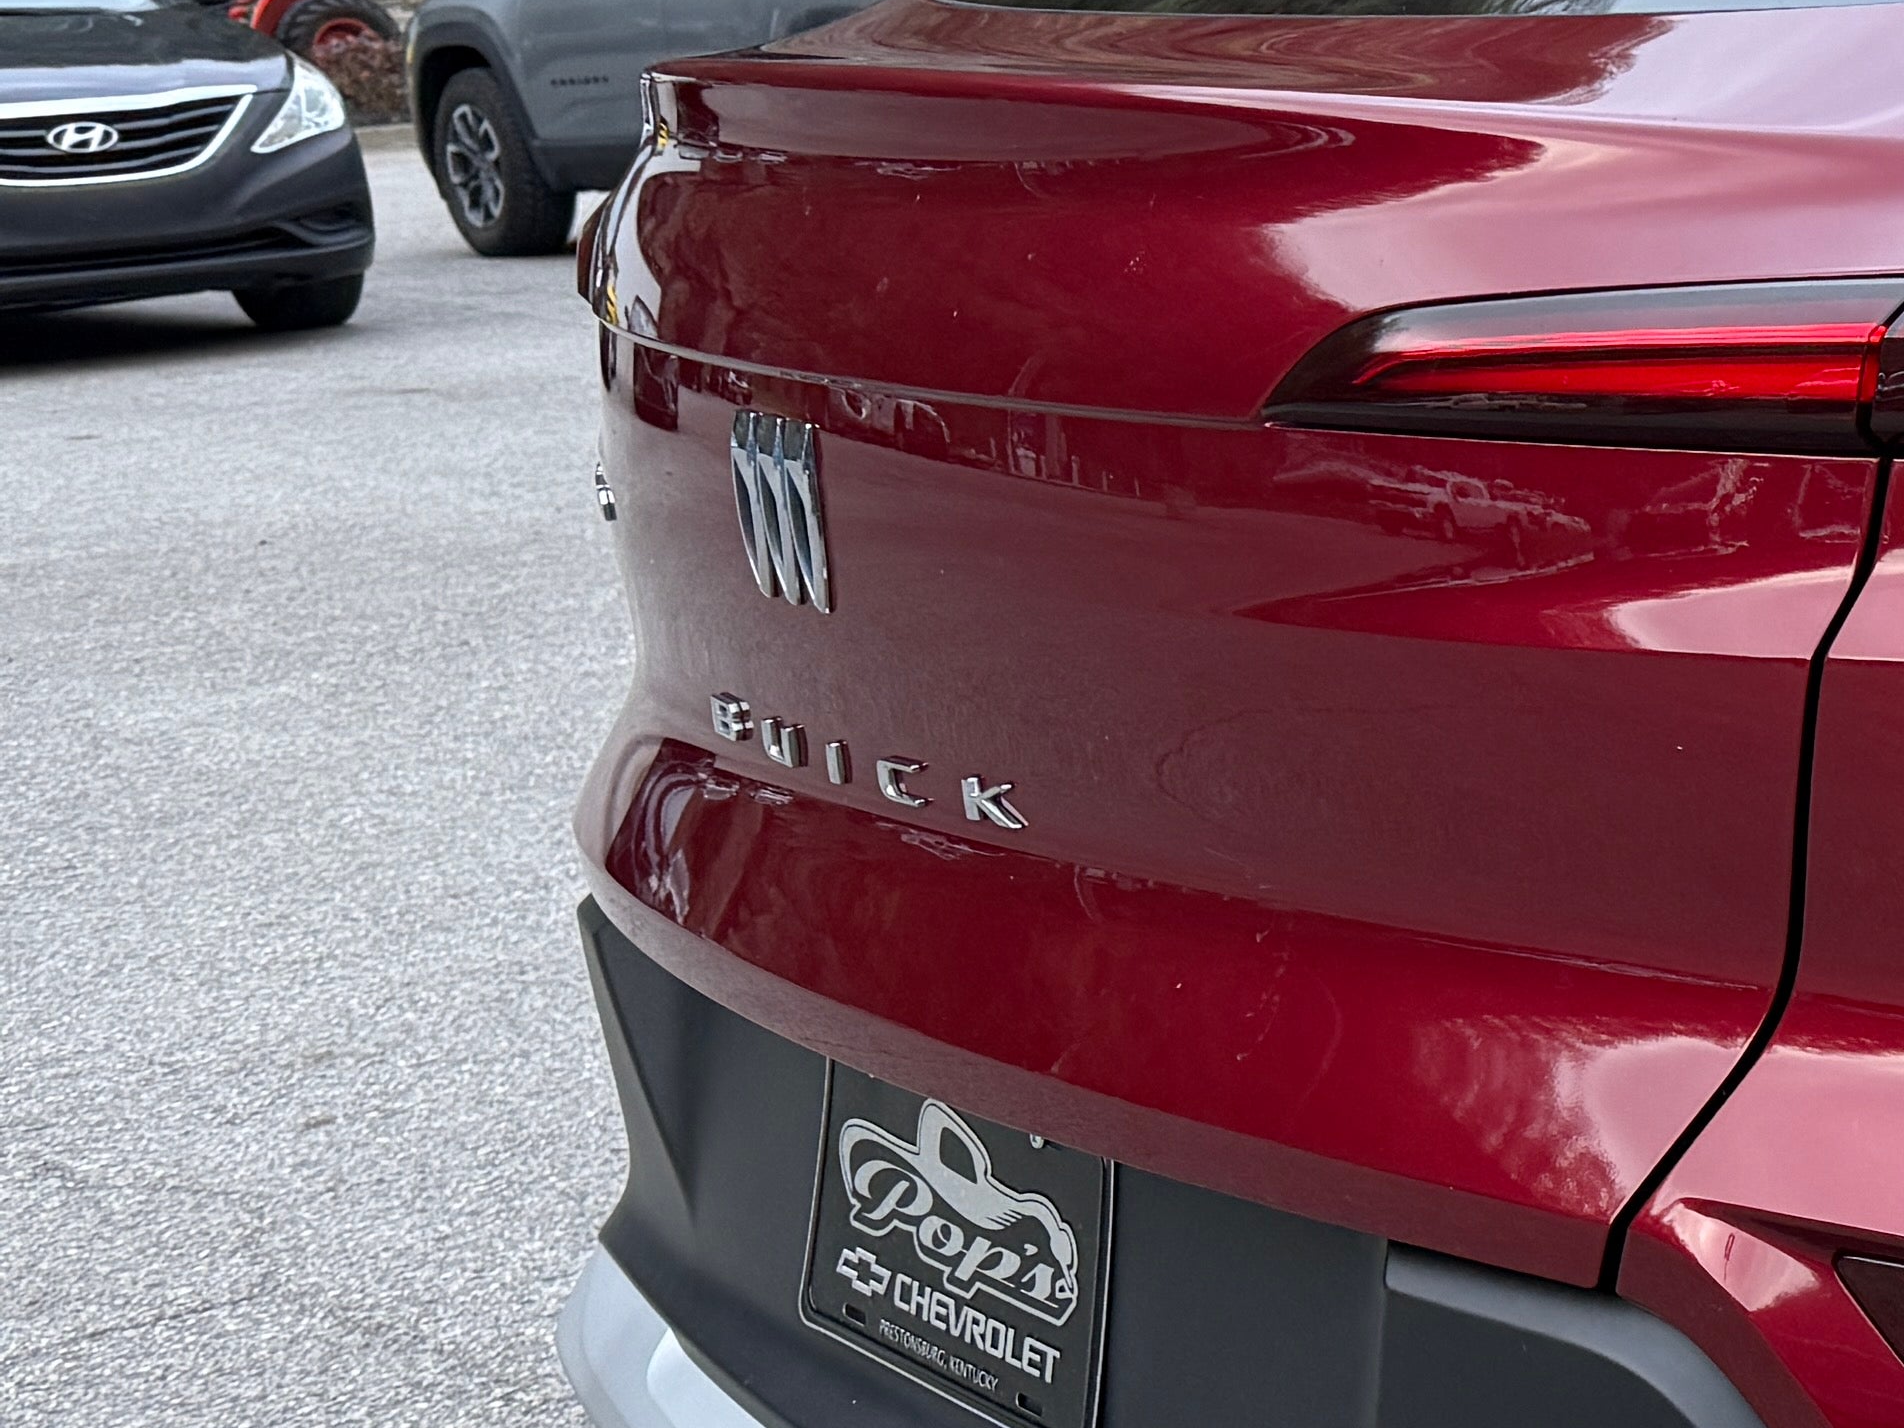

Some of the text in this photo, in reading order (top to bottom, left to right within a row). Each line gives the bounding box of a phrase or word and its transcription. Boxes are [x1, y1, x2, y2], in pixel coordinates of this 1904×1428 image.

[710, 691, 1029, 830] BUICK
[853, 1159, 1058, 1306] Pop's
[893, 1273, 1061, 1383] CHEVROLET
[949, 1355, 999, 1392] KENTUCKY
